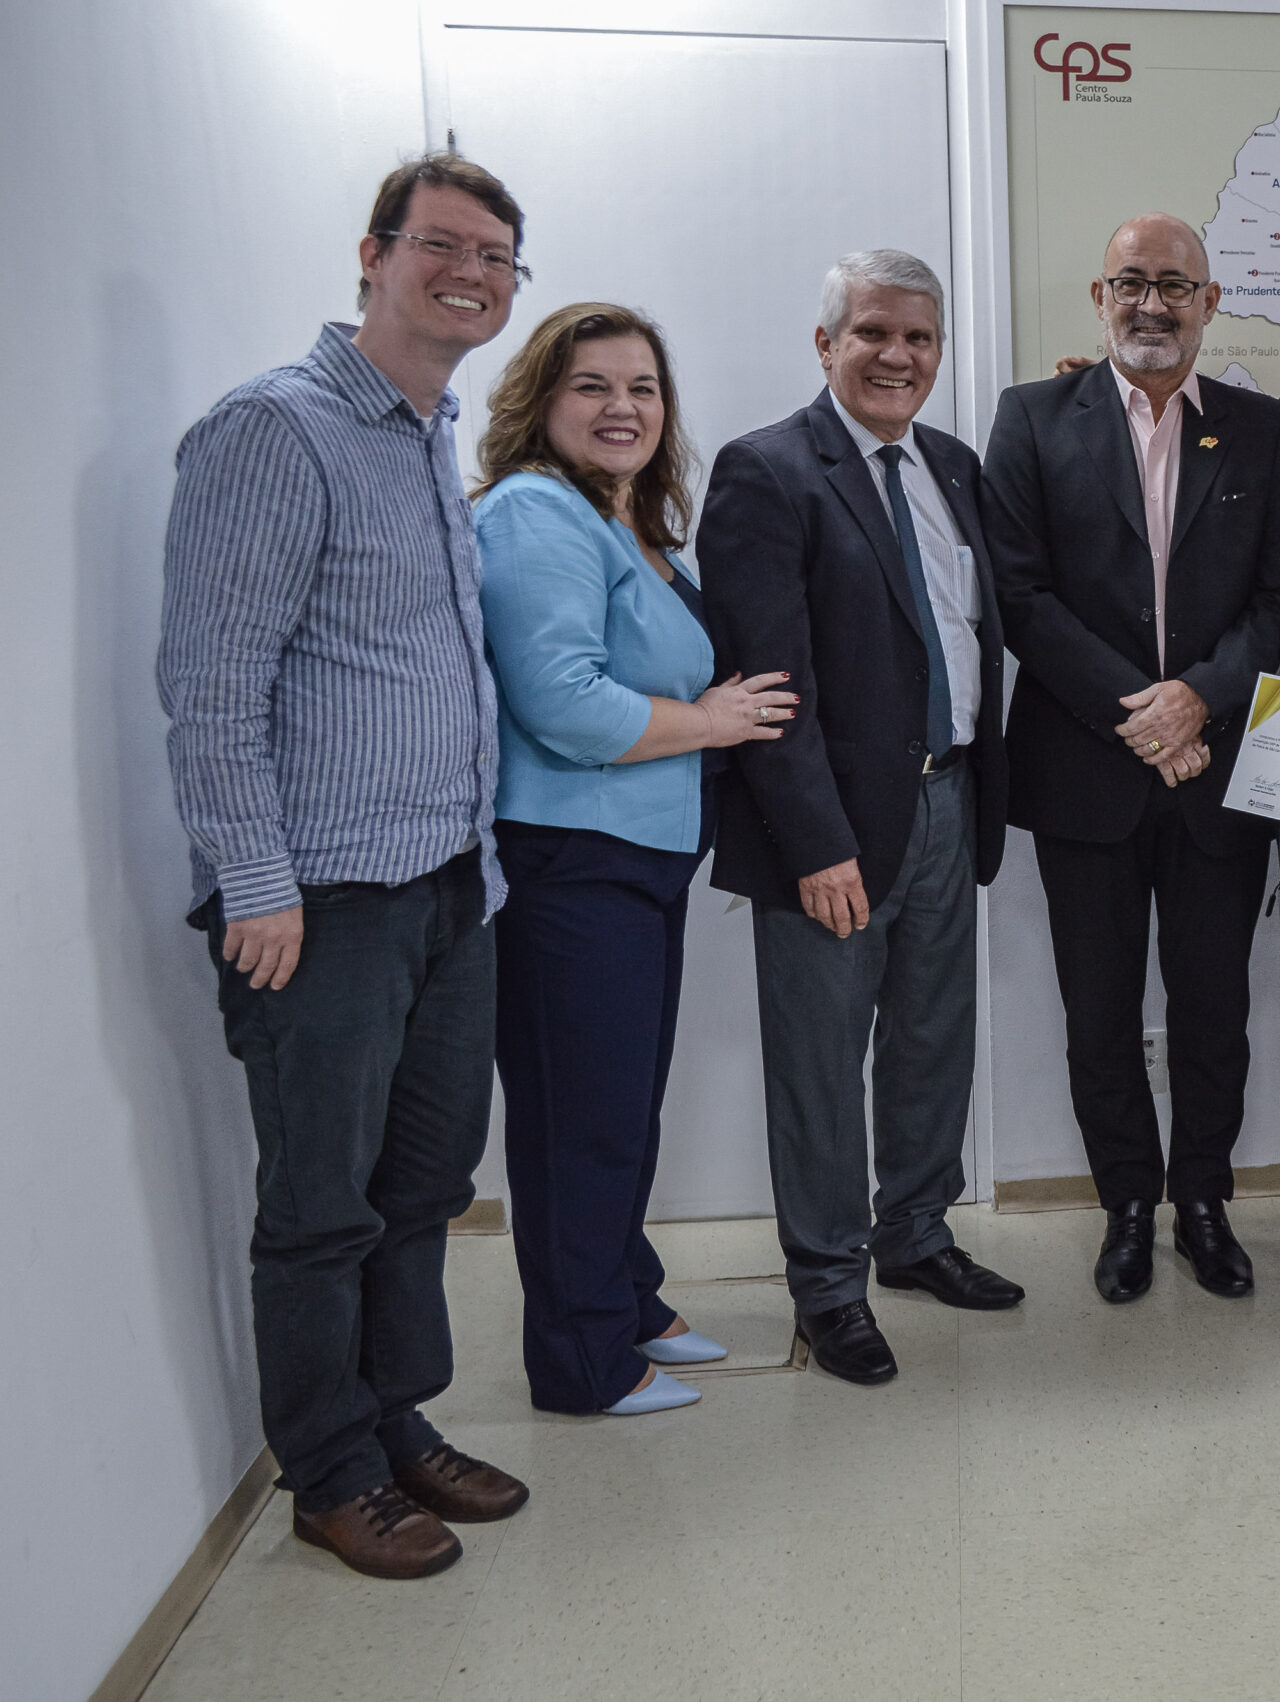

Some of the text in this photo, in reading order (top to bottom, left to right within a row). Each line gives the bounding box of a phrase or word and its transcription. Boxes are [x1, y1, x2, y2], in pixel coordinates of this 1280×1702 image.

[1075, 84, 1108, 93] Centro
[1075, 94, 1132, 103] Paula Souza
[1211, 346, 1224, 356] de
[1228, 346, 1247, 356] São
[1250, 346, 1279, 356] Paulo
